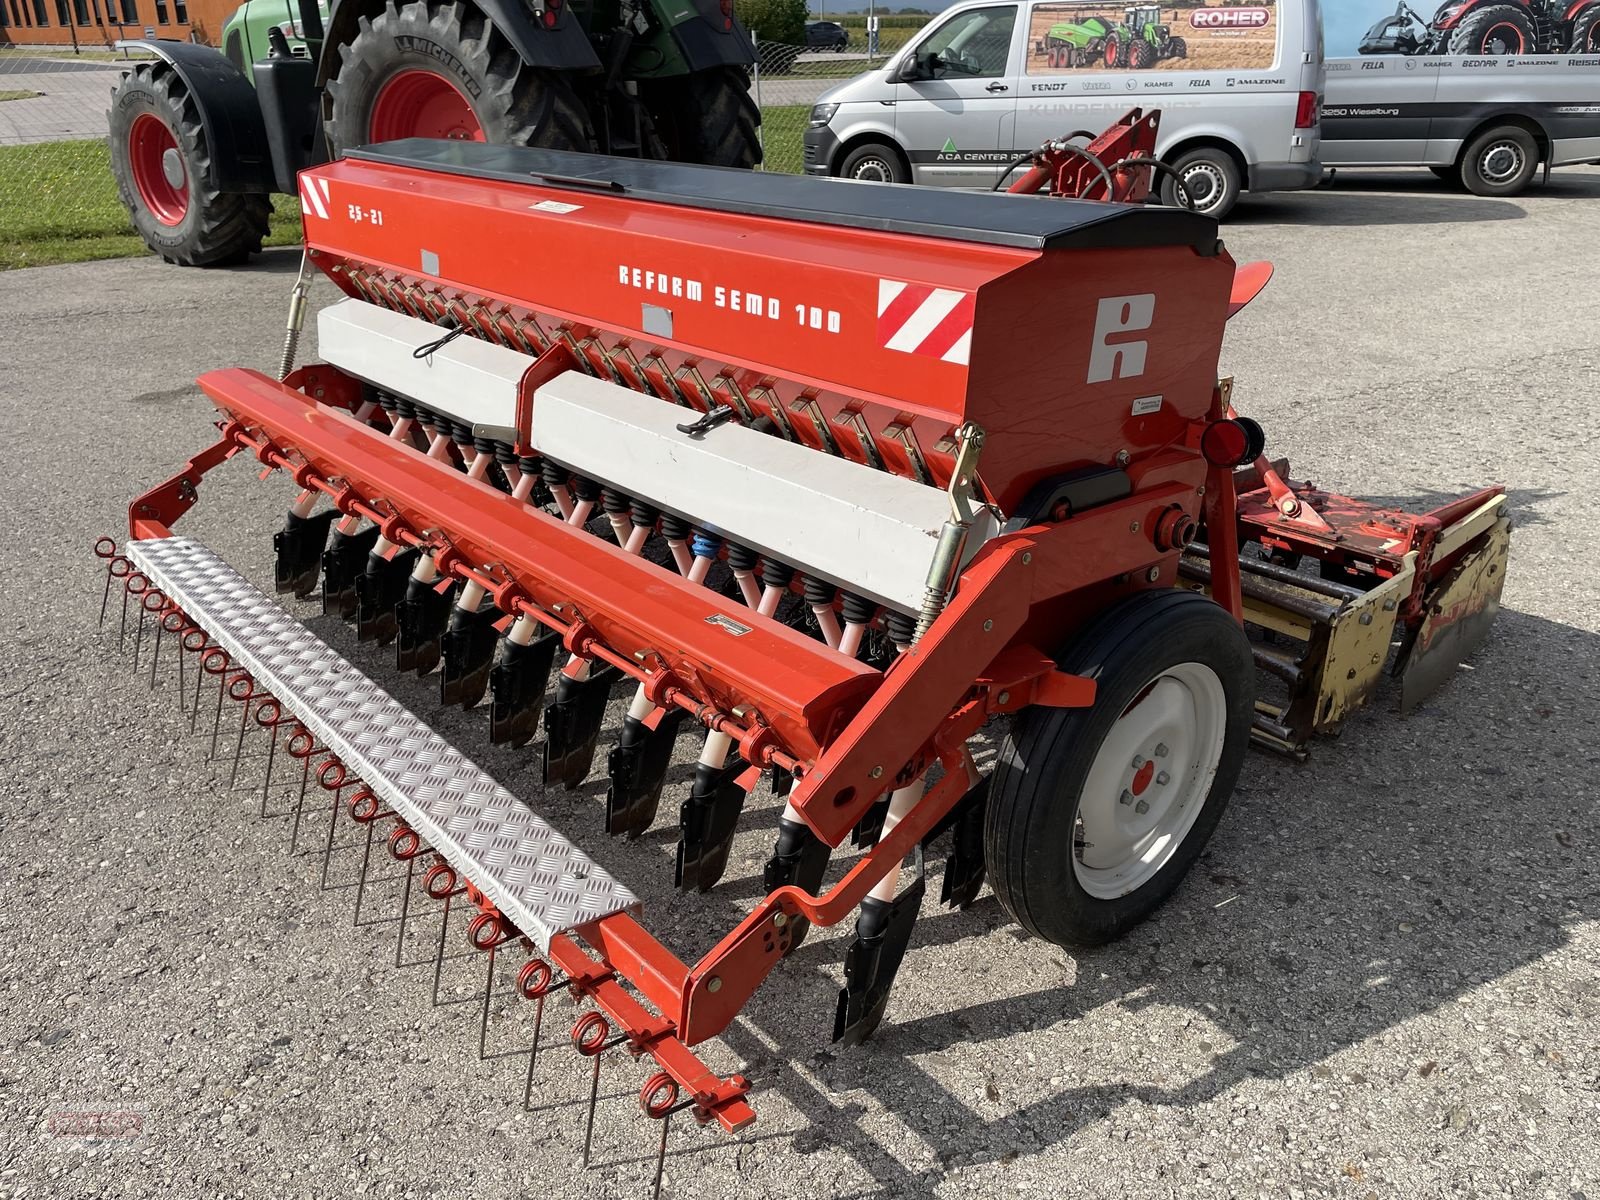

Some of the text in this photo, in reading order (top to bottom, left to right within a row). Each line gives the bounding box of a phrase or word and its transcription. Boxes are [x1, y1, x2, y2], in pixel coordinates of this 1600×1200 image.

[1193, 11, 1266, 26] ROHER
[413, 37, 481, 97] MICHELIN
[1361, 61, 1385, 70] FELLA
[1568, 59, 1600, 67] Reisc
[1031, 82, 1068, 91] FENDT
[1189, 79, 1211, 87] FELLA
[1321, 108, 1400, 116] 3250 Wieselburg
[937, 153, 962, 161] ACA
[964, 153, 1008, 161] CENTER
[619, 264, 841, 334] REFORM SEMO 100
